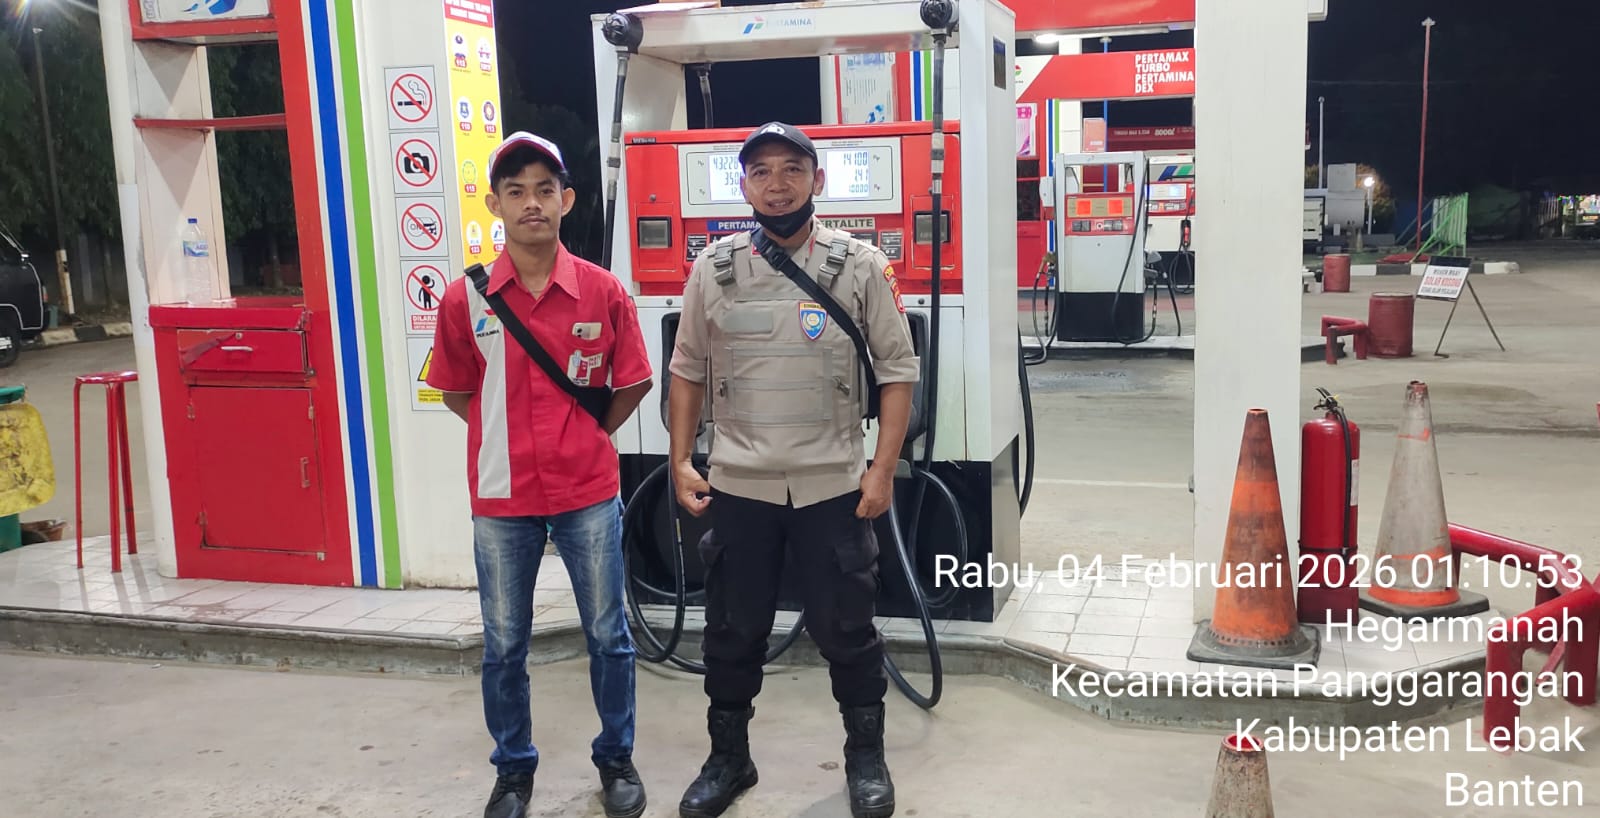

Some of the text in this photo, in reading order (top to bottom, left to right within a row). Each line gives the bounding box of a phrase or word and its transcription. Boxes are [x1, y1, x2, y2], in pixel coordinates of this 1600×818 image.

[1135, 51, 1189, 65] PERTAMAX
[1135, 62, 1171, 73] TURBO
[1135, 71, 1194, 83] PERTAMINA
[1135, 83, 1154, 93] DEX
[843, 151, 868, 166] 14100
[718, 221, 760, 230] PERTAMA
[820, 218, 873, 228] ERTALITE
[412, 315, 436, 323] DILARA
